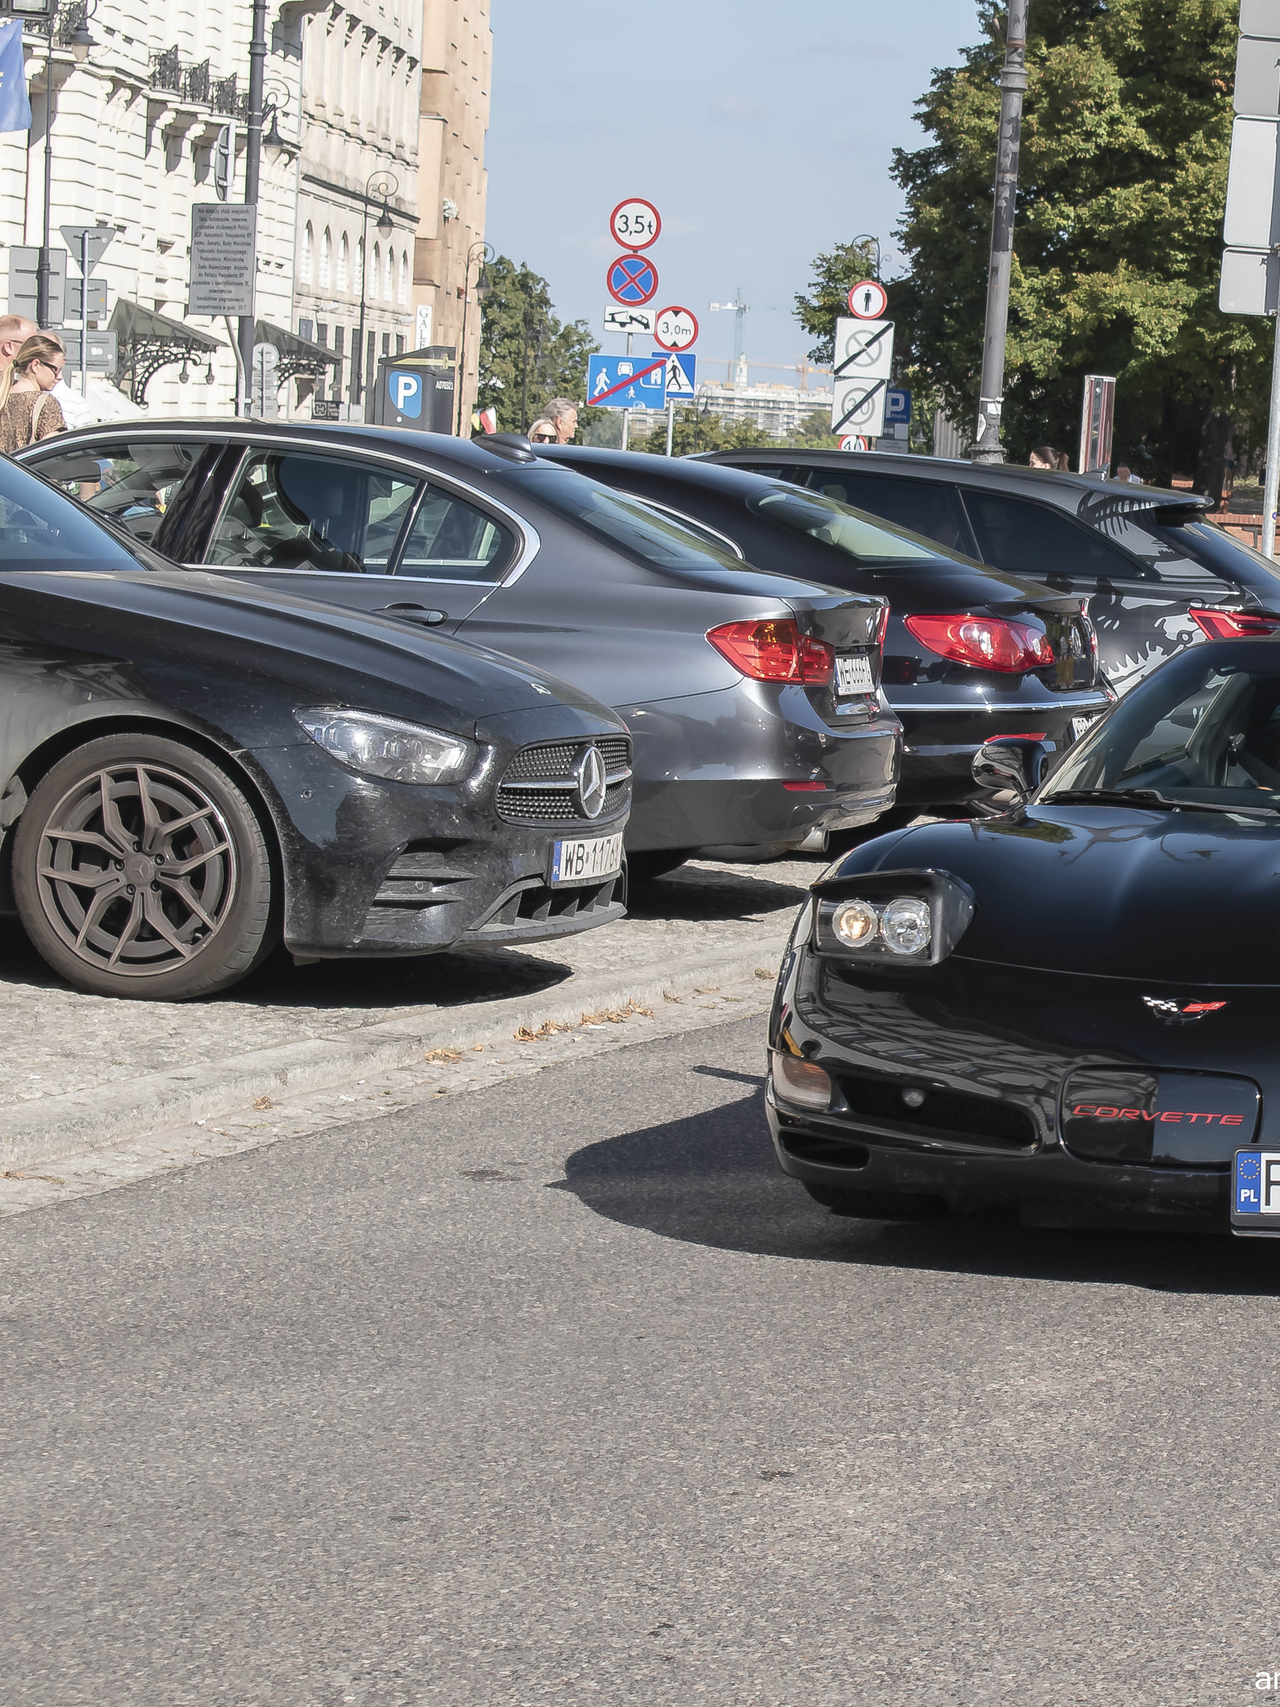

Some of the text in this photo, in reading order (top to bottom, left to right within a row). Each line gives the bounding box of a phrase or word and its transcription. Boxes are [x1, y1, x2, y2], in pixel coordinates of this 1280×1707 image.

[617, 214, 654, 236] 3,5t
[662, 322, 692, 336] 3,0m
[398, 376, 418, 408] P
[886, 392, 905, 418] P
[564, 844, 585, 876] WB
[1072, 1104, 1244, 1126] CORVETTE
[1240, 1189, 1259, 1203] PL
